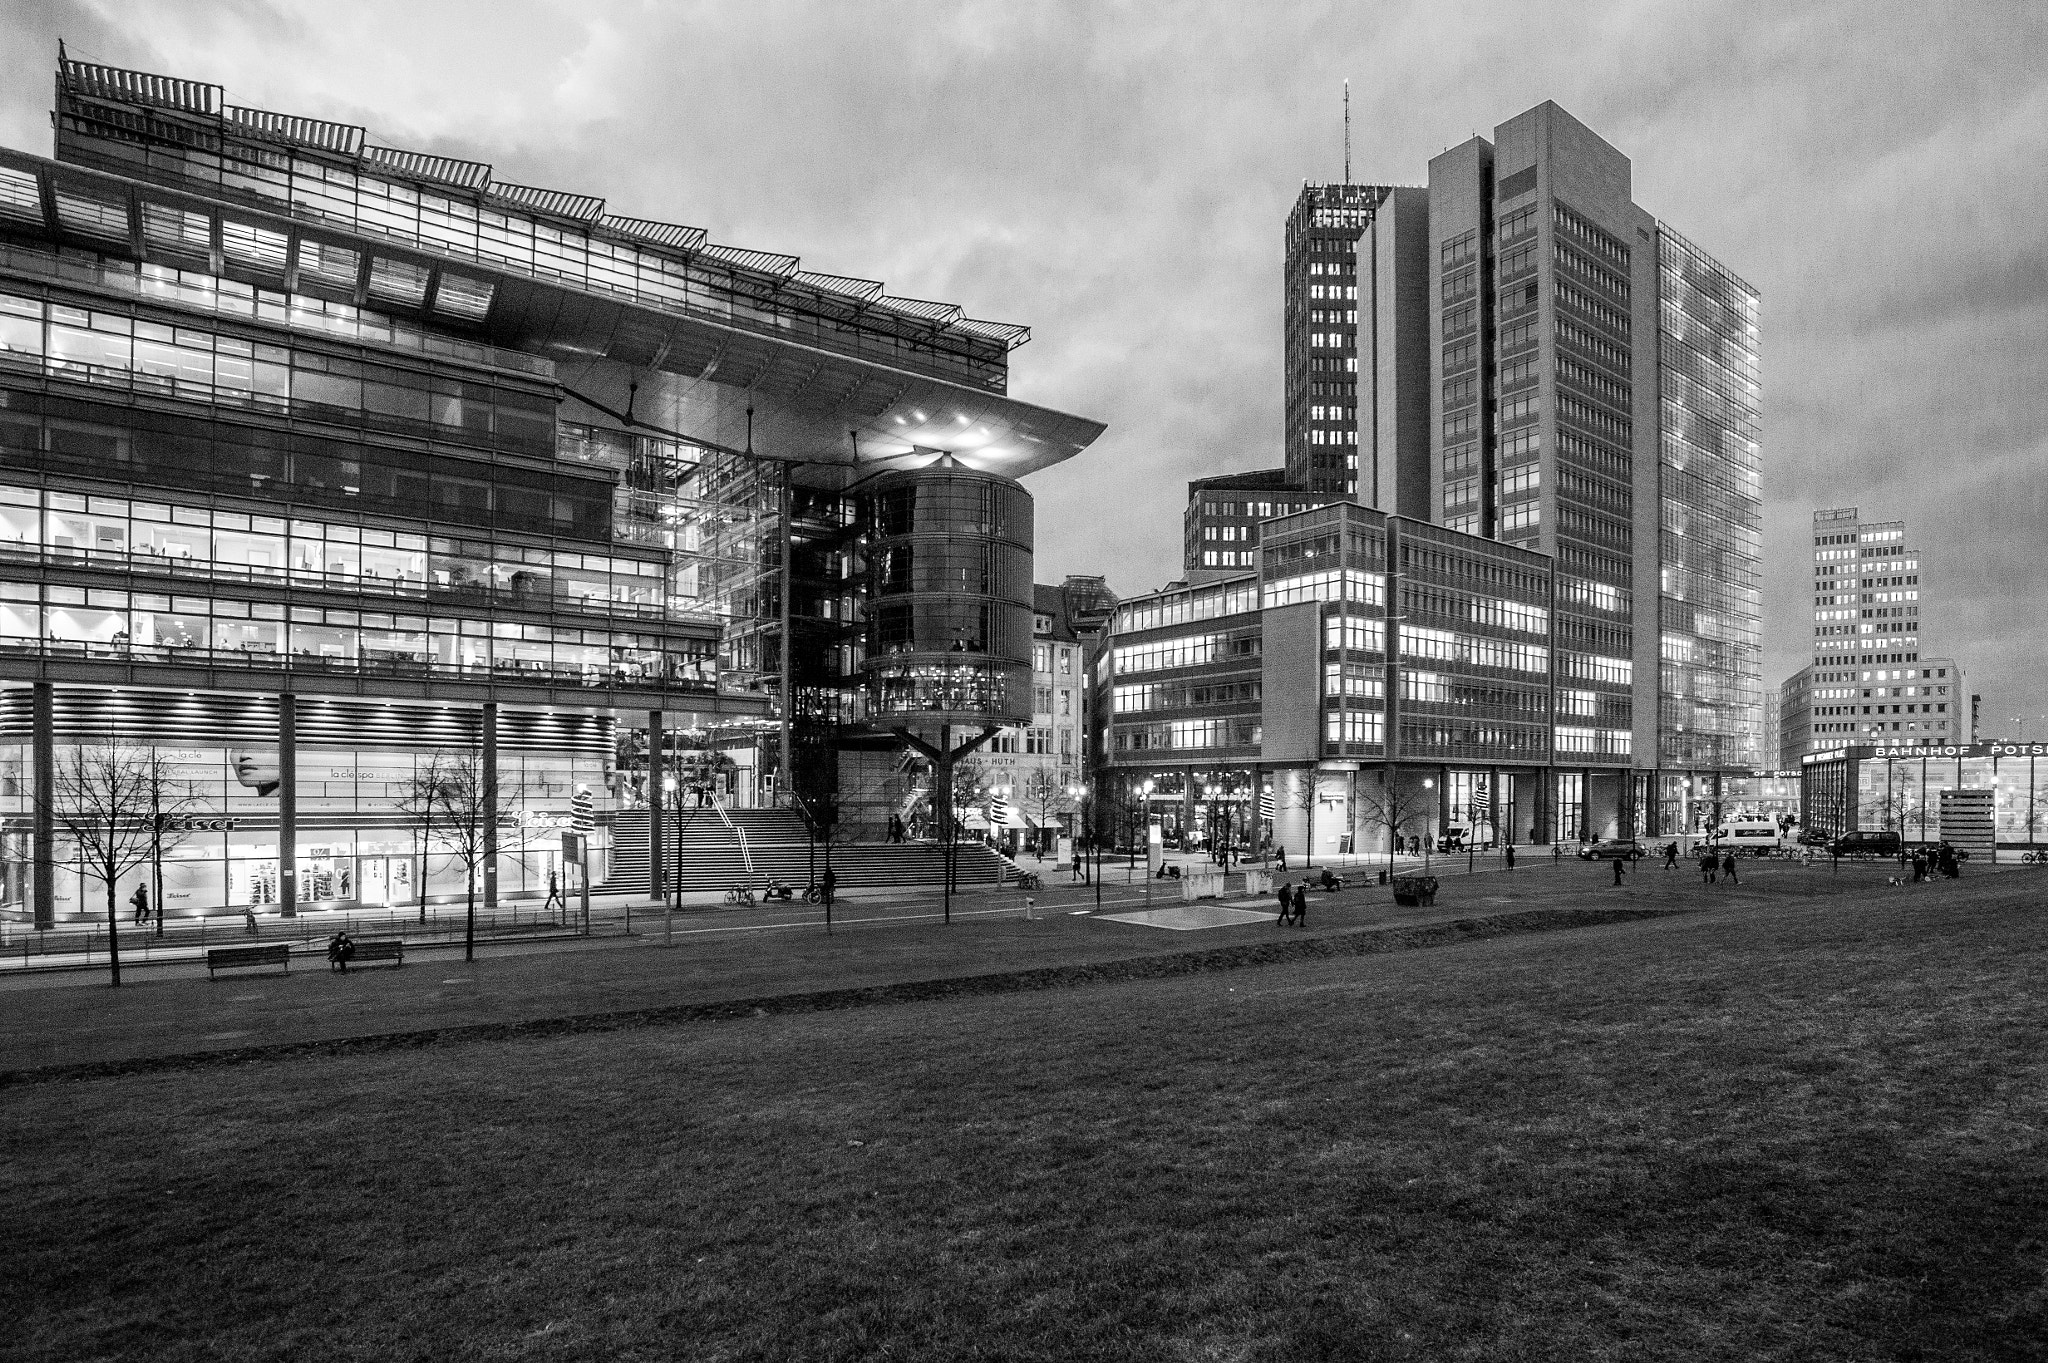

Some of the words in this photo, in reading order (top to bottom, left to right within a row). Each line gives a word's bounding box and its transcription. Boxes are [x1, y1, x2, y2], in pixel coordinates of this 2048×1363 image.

[1875, 746, 1970, 756] BAHNHOF
[1991, 745, 2048, 755] POTS
[991, 757, 1016, 766] HUTH
[330, 768, 339, 778] la
[357, 772, 374, 780] spa
